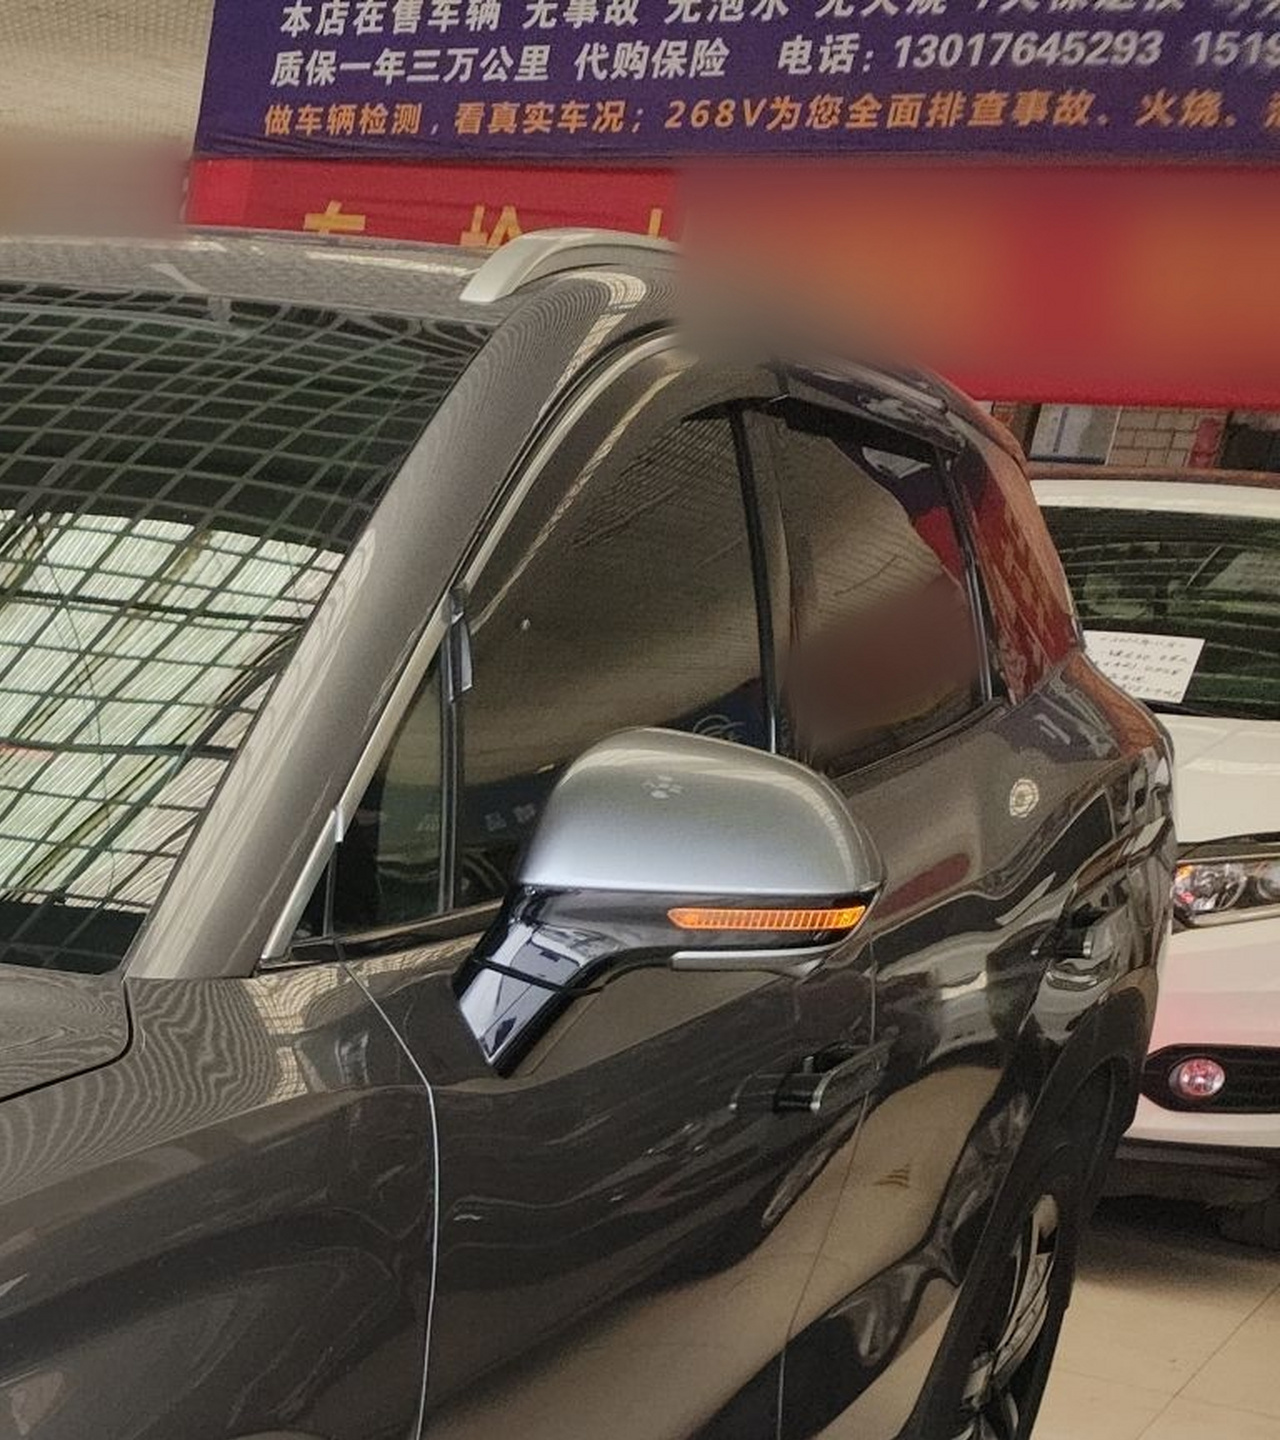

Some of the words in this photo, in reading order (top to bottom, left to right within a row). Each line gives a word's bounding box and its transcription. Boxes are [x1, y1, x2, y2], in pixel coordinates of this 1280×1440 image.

[279, 0, 501, 37] 本店在售车辆
[269, 44, 552, 87] 质保一年三万公里
[574, 37, 731, 80] 代购保险
